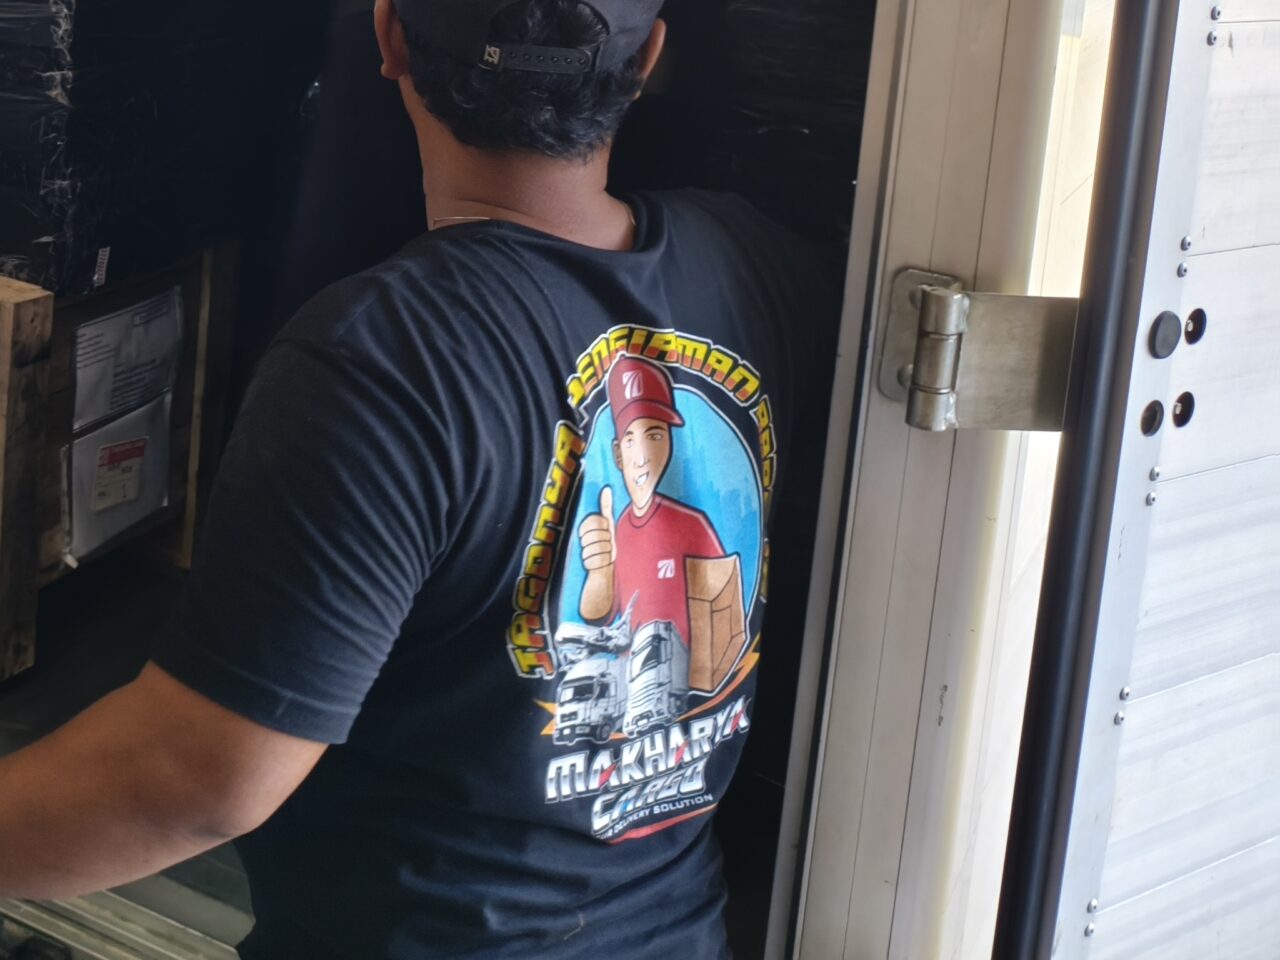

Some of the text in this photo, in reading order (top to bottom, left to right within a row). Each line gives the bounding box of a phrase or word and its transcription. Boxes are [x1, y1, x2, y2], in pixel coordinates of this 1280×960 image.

[545, 696, 751, 804] MAKHARYA
[592, 756, 708, 836] CARGO
[653, 793, 714, 814] SOLUTION
